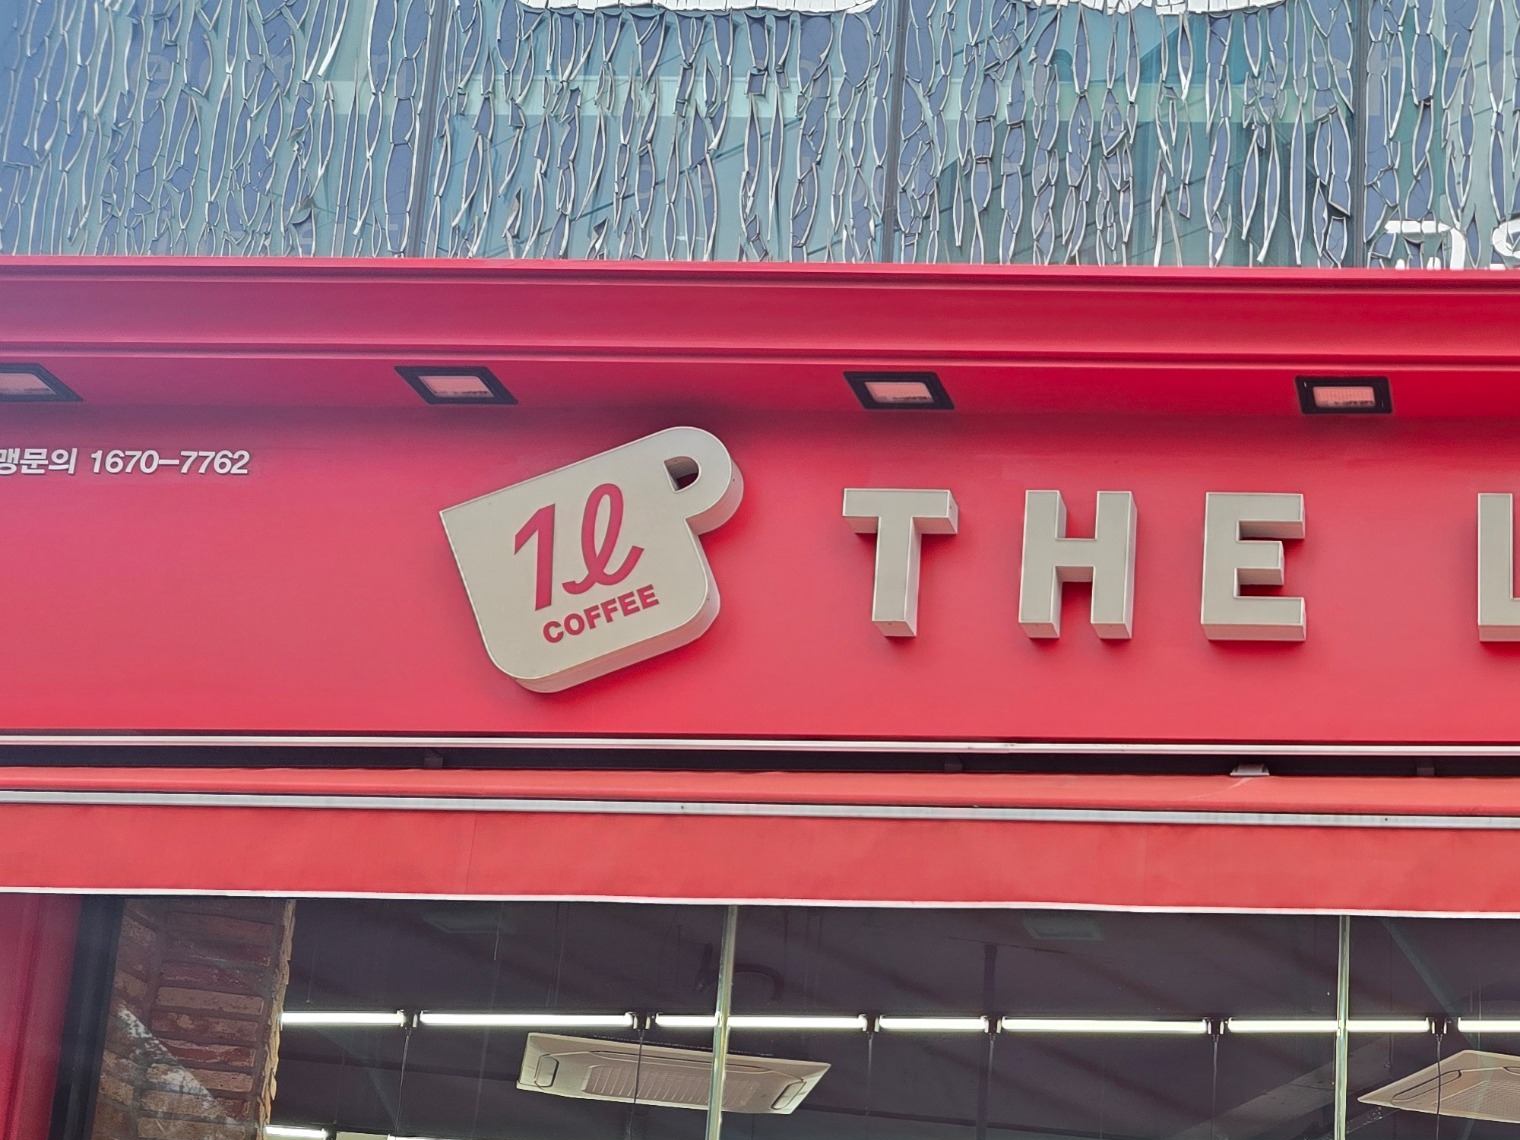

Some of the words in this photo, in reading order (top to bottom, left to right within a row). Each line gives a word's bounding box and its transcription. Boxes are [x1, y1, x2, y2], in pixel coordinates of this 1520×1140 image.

[90, 449, 251, 475] 1670-7762
[842, 487, 1308, 644] THE
[541, 584, 661, 643] COFFEE
